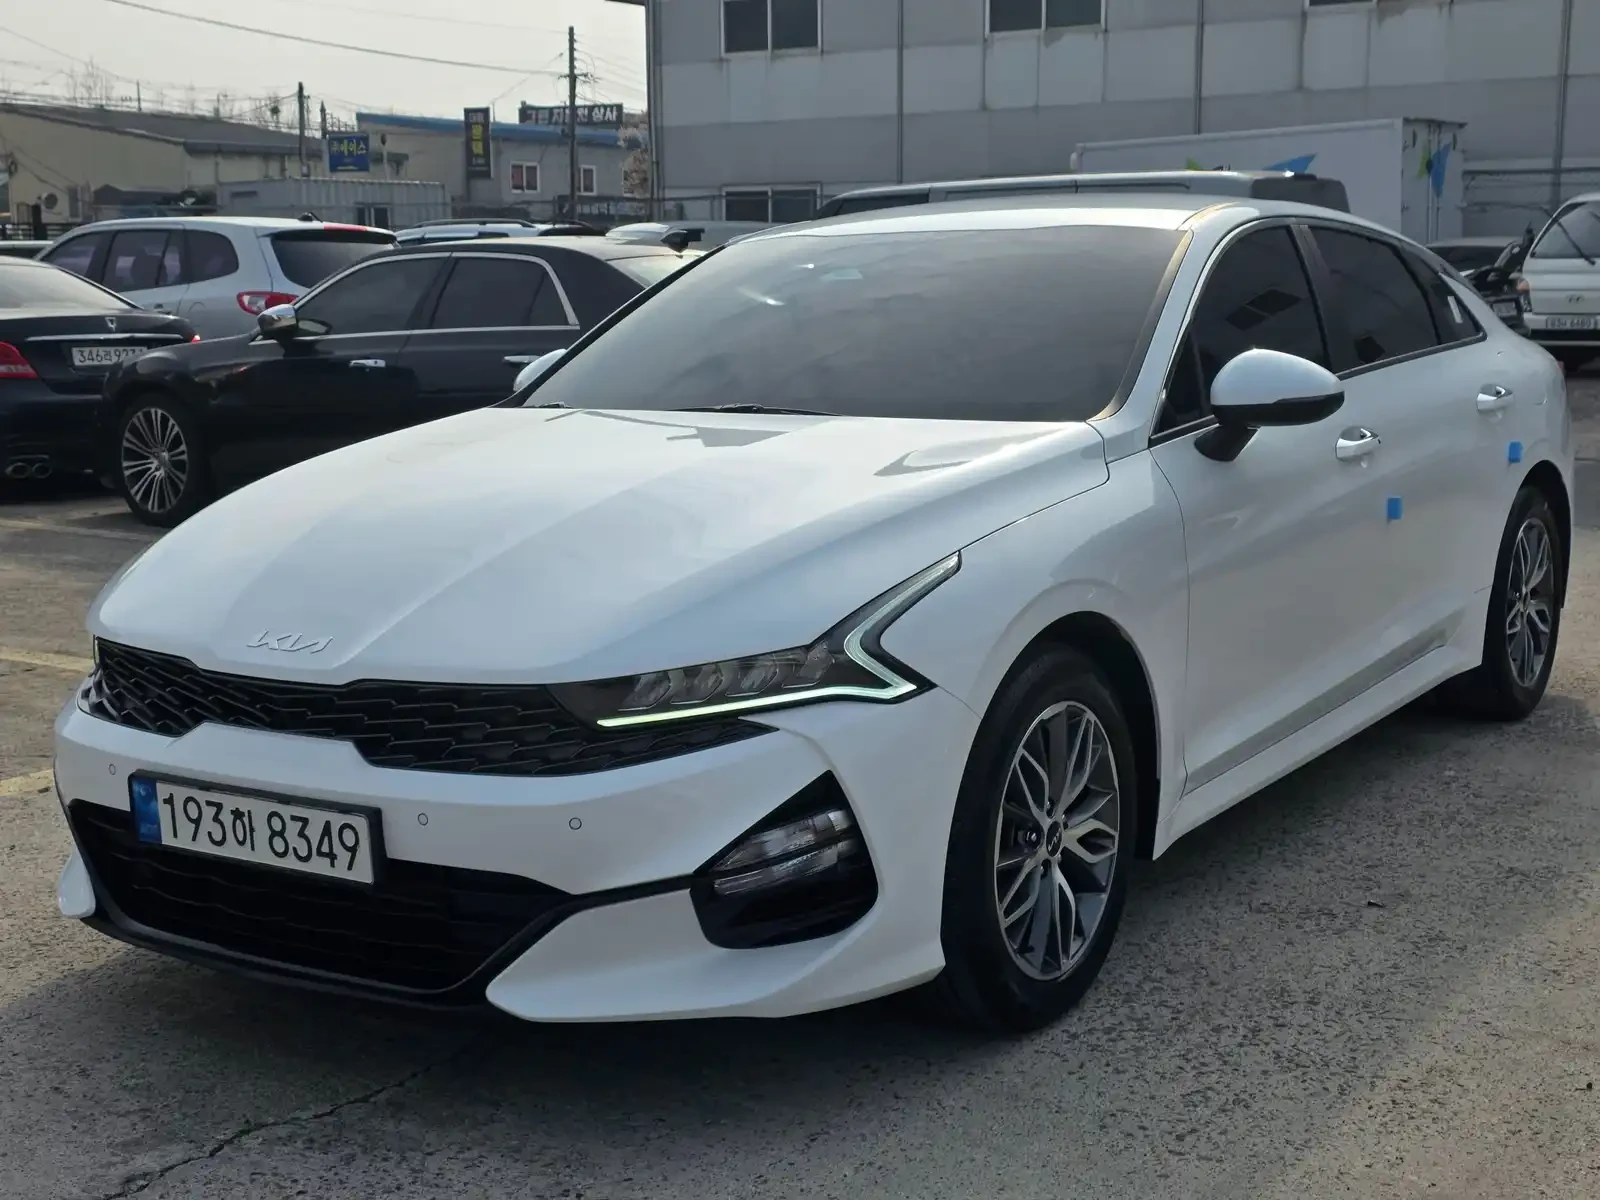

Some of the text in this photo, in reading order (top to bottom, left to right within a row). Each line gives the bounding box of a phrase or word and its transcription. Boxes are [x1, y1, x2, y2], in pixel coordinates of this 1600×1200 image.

[245, 628, 334, 655] KIA
[163, 792, 361, 872] 193하 8349
